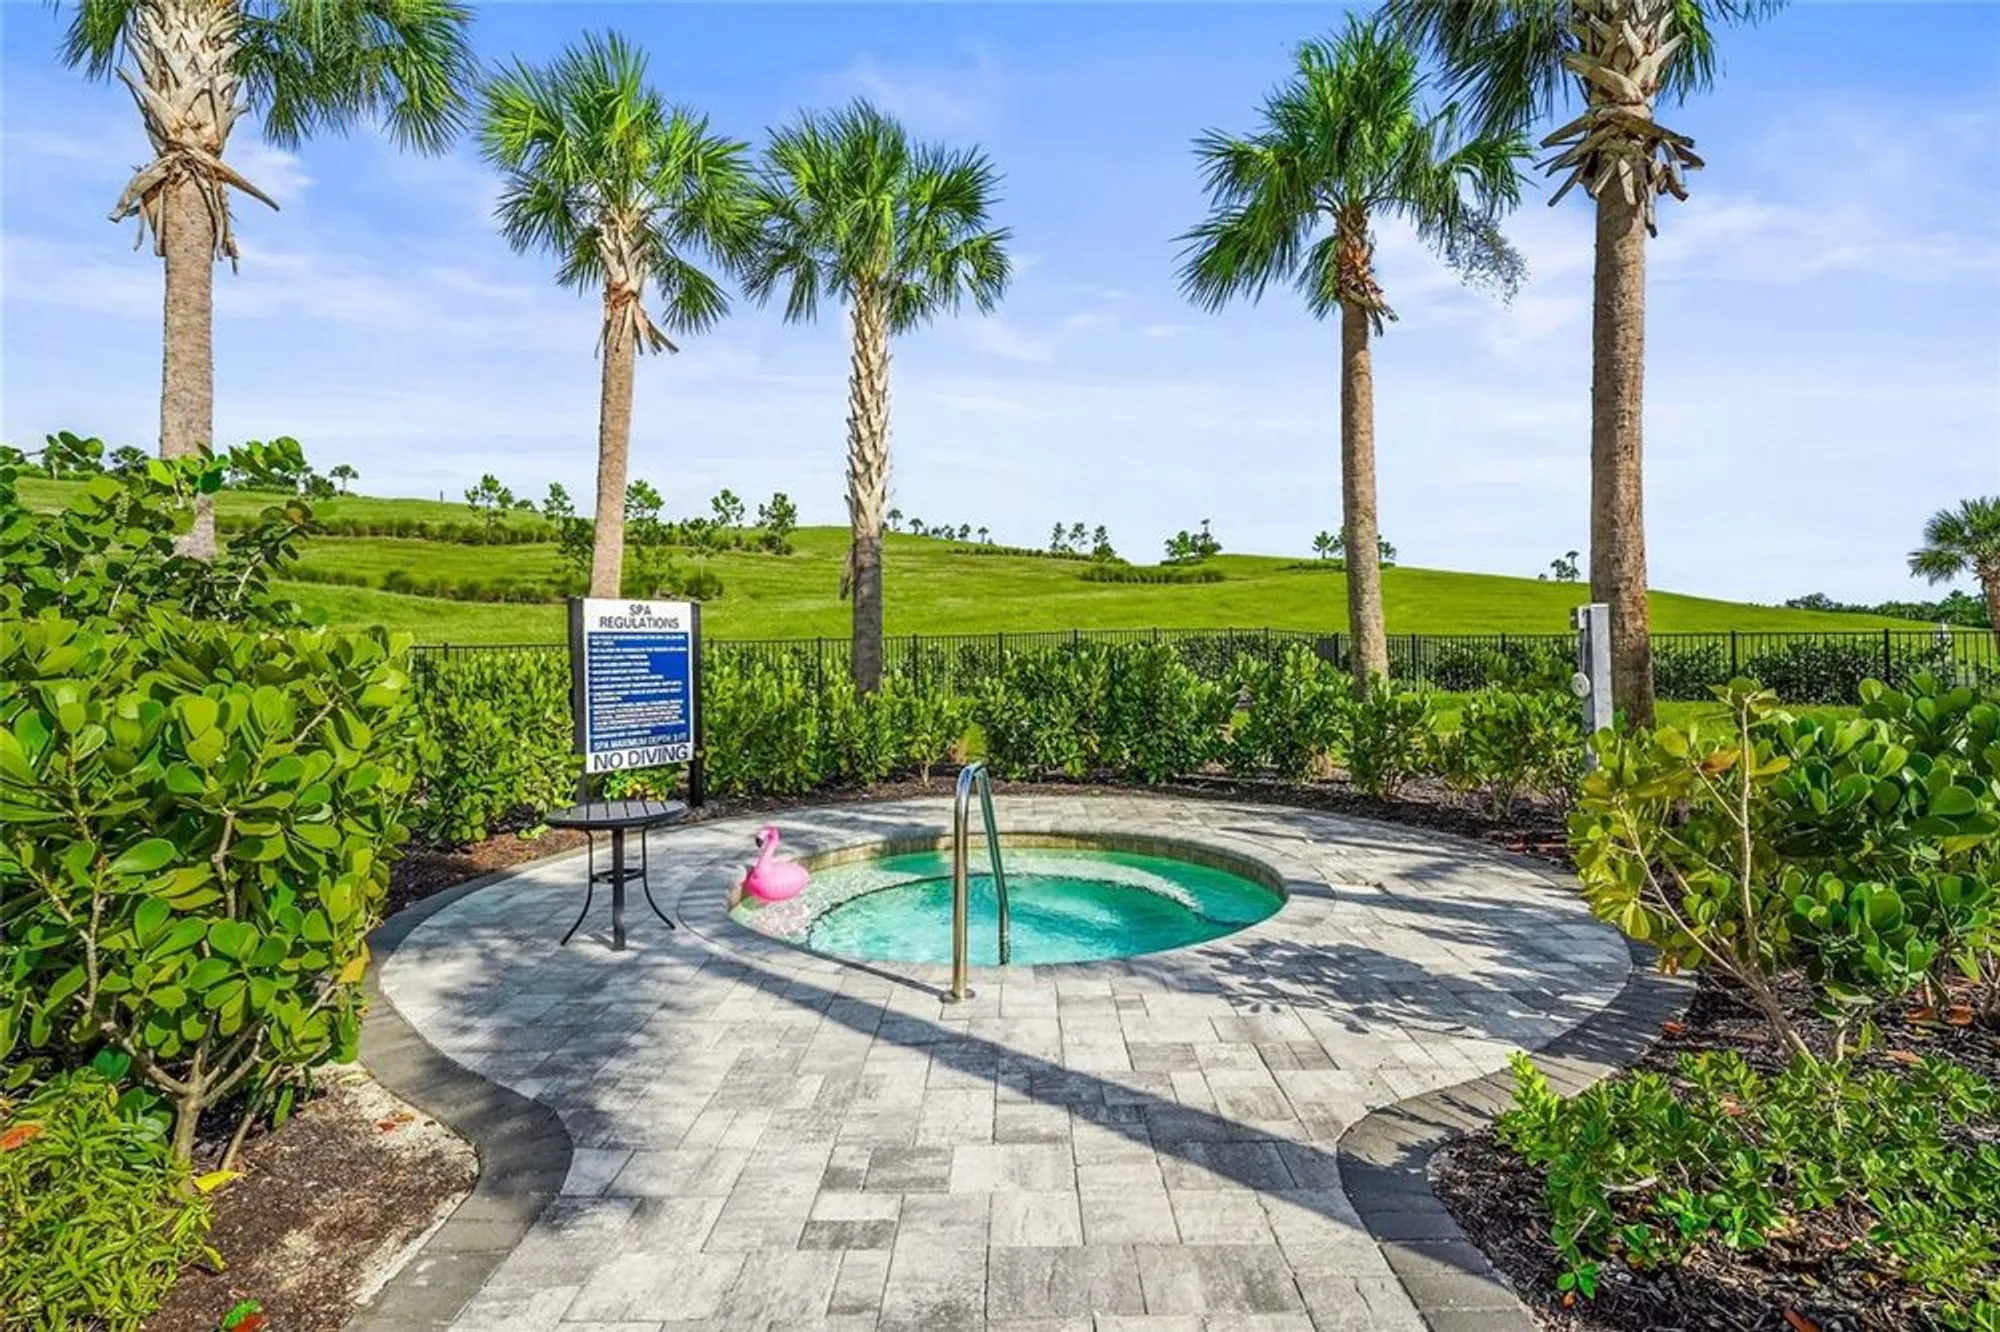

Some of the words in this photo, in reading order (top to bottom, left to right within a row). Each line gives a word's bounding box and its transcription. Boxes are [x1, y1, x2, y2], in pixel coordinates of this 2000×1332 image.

[629, 604, 651, 616] SPA
[599, 616, 679, 629] REGULATIONS
[594, 752, 623, 771] NO
[628, 744, 688, 766] DIVING
